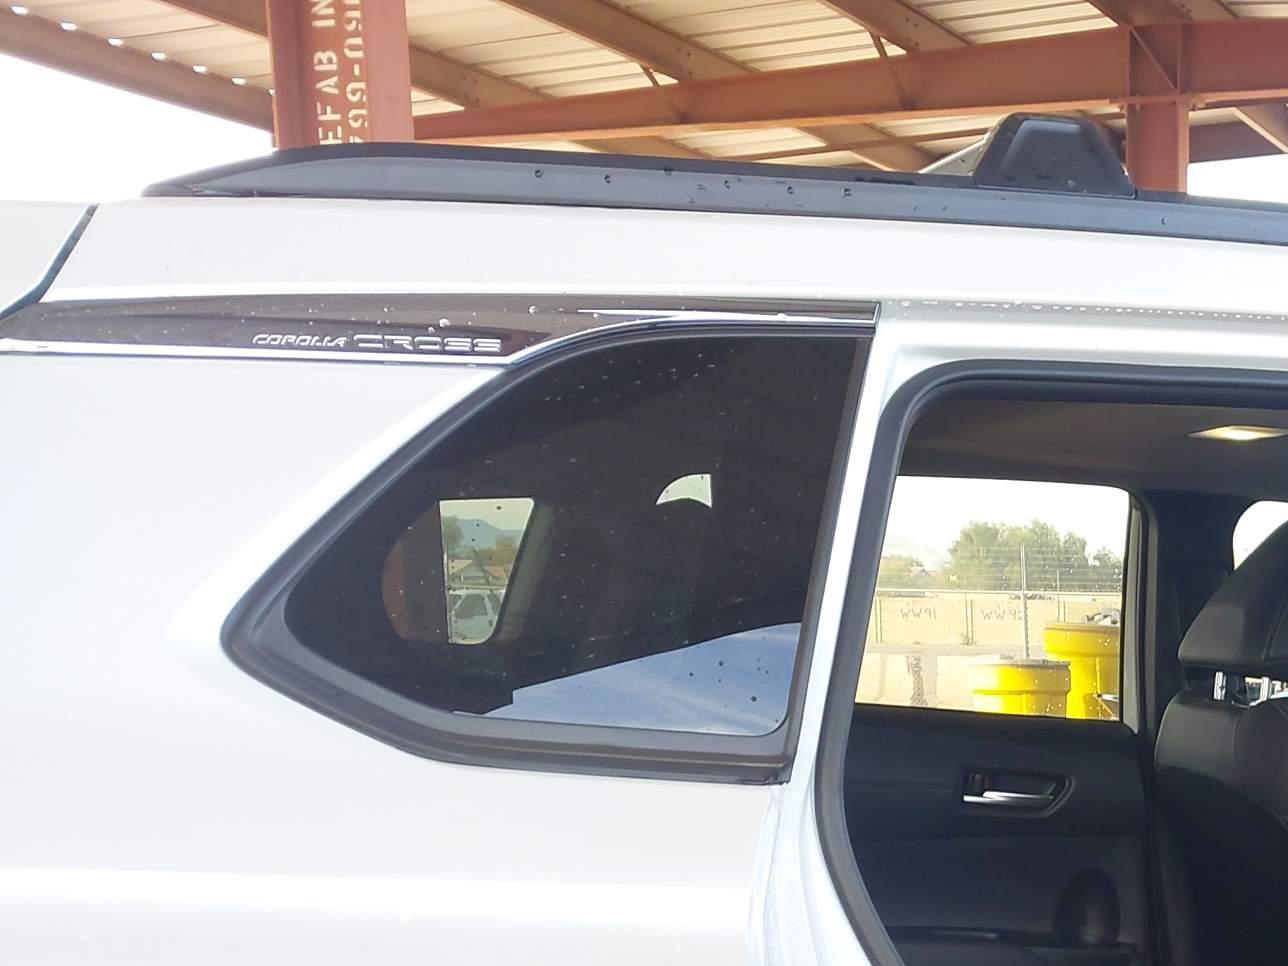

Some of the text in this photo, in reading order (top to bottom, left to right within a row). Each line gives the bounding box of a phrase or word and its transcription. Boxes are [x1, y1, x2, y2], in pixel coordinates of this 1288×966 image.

[344, 0, 368, 143] 99-09
[253, 333, 502, 353] COROLLA CROSS
